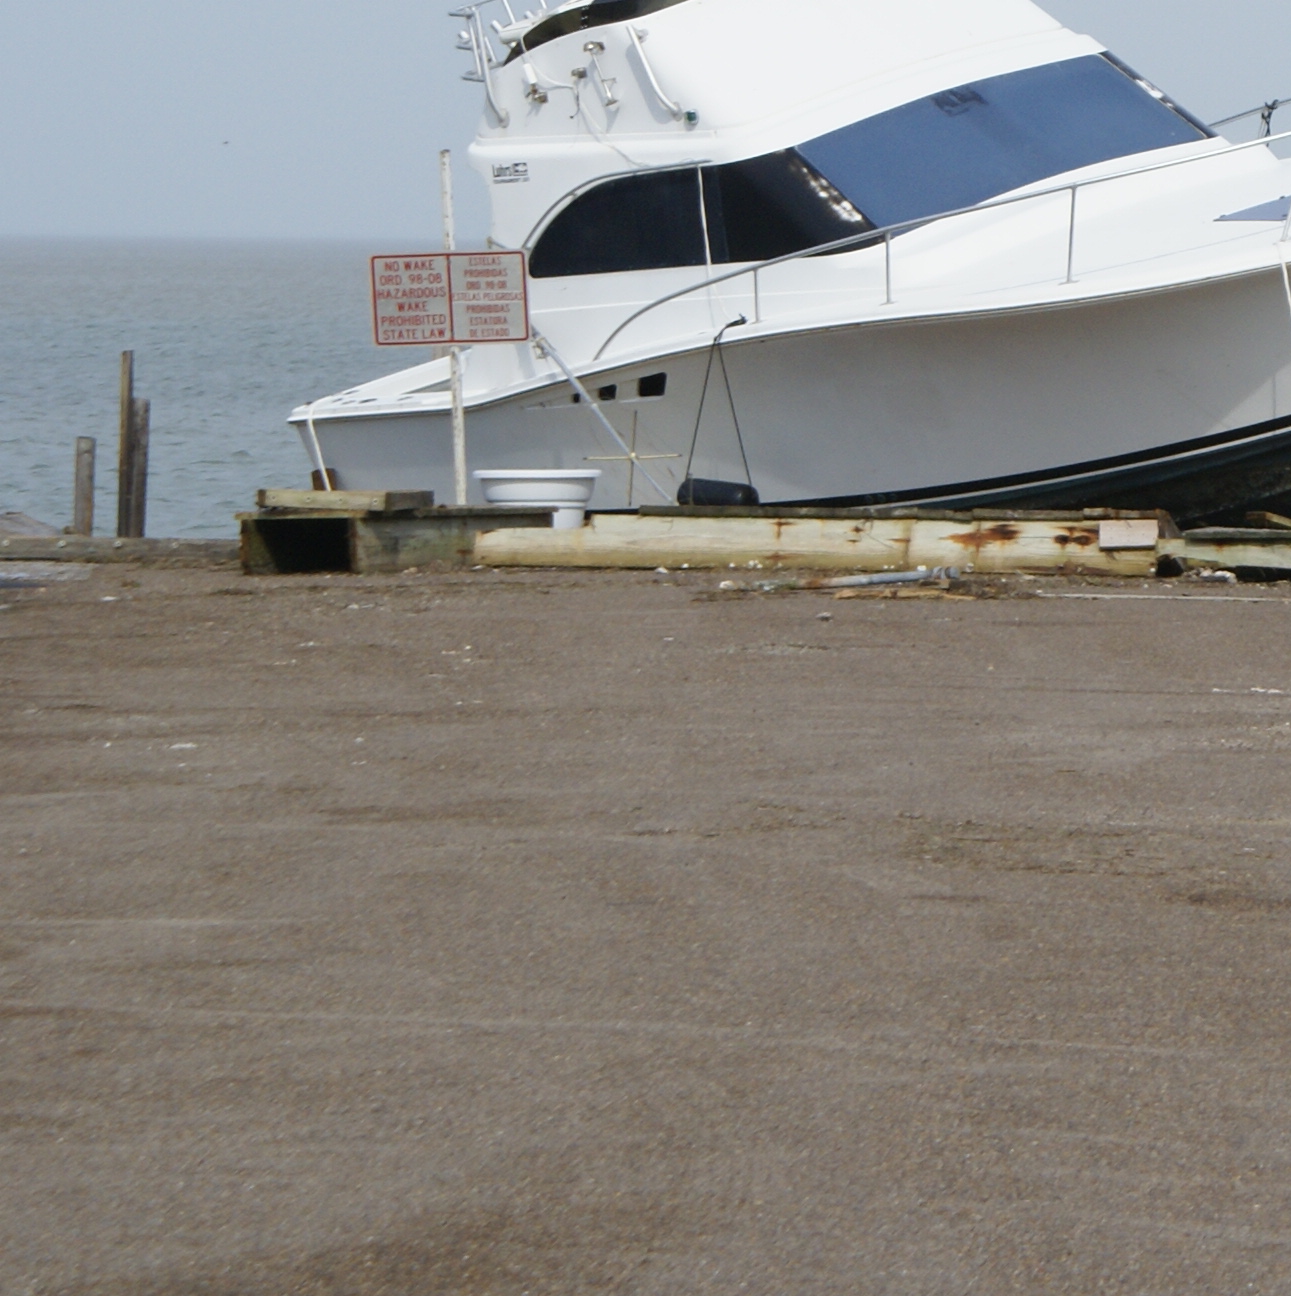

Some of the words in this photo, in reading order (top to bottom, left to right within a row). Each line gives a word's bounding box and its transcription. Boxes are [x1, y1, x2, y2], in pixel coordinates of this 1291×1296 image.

[384, 261, 400, 272] NO
[404, 259, 435, 271] WAKE
[469, 257, 502, 267] ESTELAS
[380, 274, 402, 286] ORD
[408, 272, 442, 285] 98-08
[463, 268, 508, 278] PROHIBIDAS
[377, 287, 447, 300] HAZARDOUS
[397, 301, 428, 313] WAKE
[466, 304, 510, 314] PROHIBIDAS
[381, 314, 447, 327] PROHIBITED
[383, 328, 418, 341] STATE
[422, 327, 447, 339] LAW
